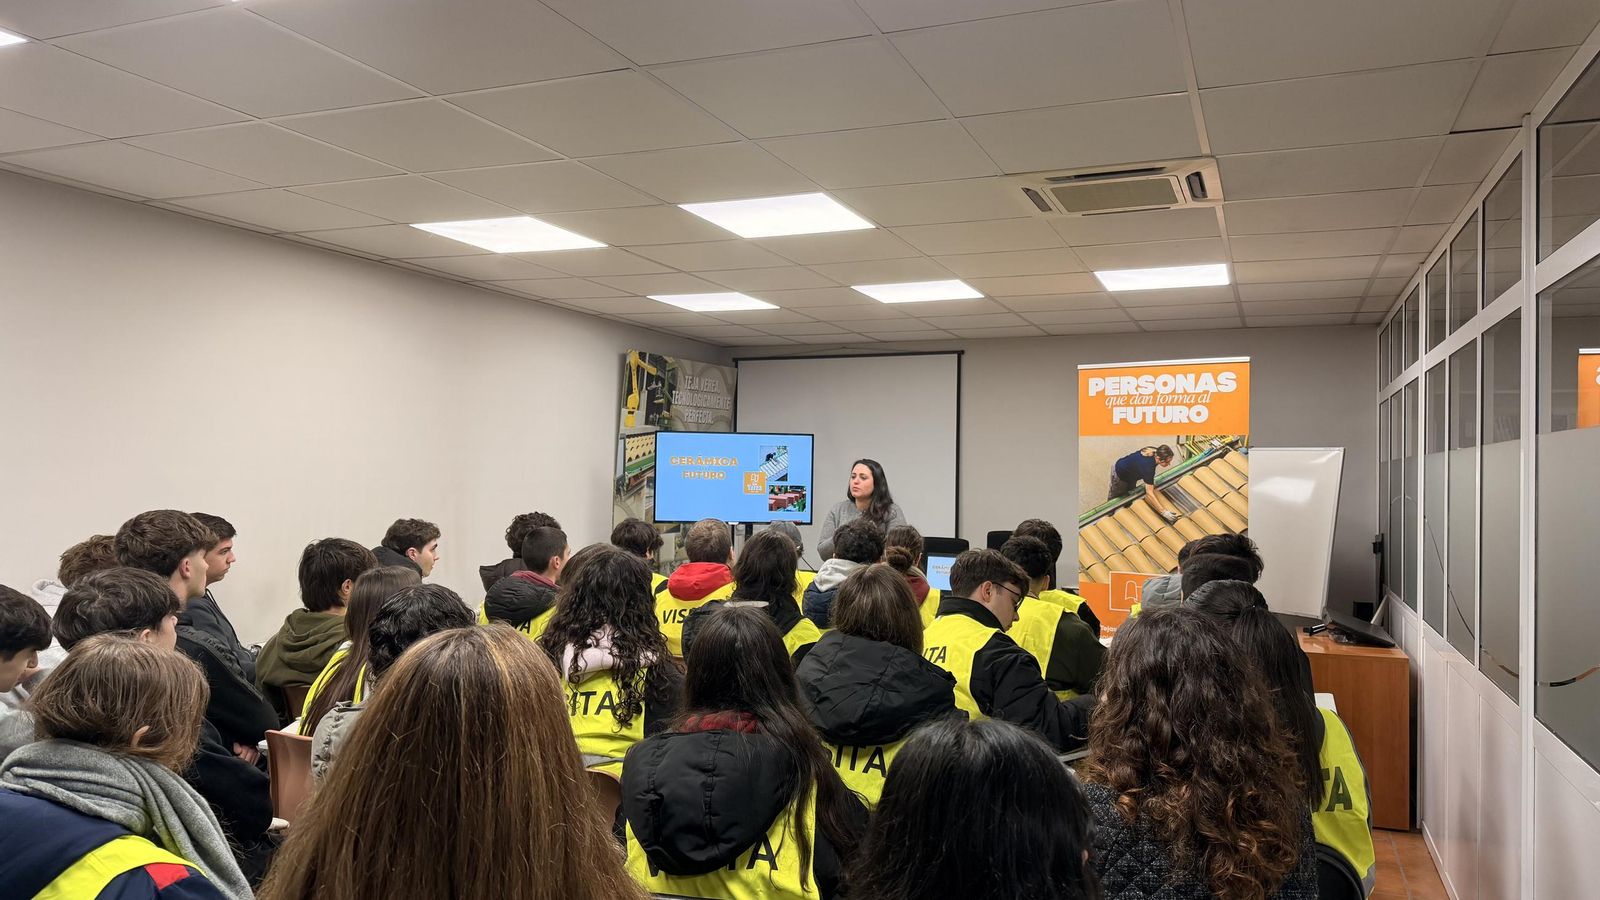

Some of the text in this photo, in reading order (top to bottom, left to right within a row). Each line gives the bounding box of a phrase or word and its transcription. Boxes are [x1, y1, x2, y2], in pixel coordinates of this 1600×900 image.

[684, 375, 699, 391] TEJA
[1088, 371, 1237, 397] PERSONAS
[1105, 391, 1212, 408] que dan forma al
[1112, 404, 1209, 425] FUTURO
[670, 455, 738, 467] CERÁMICA
[682, 471, 726, 480] FUTURO
[663, 608, 693, 624] VIS
[923, 646, 947, 664] ITA
[570, 690, 616, 716] ITA
[834, 744, 887, 779] ITA
